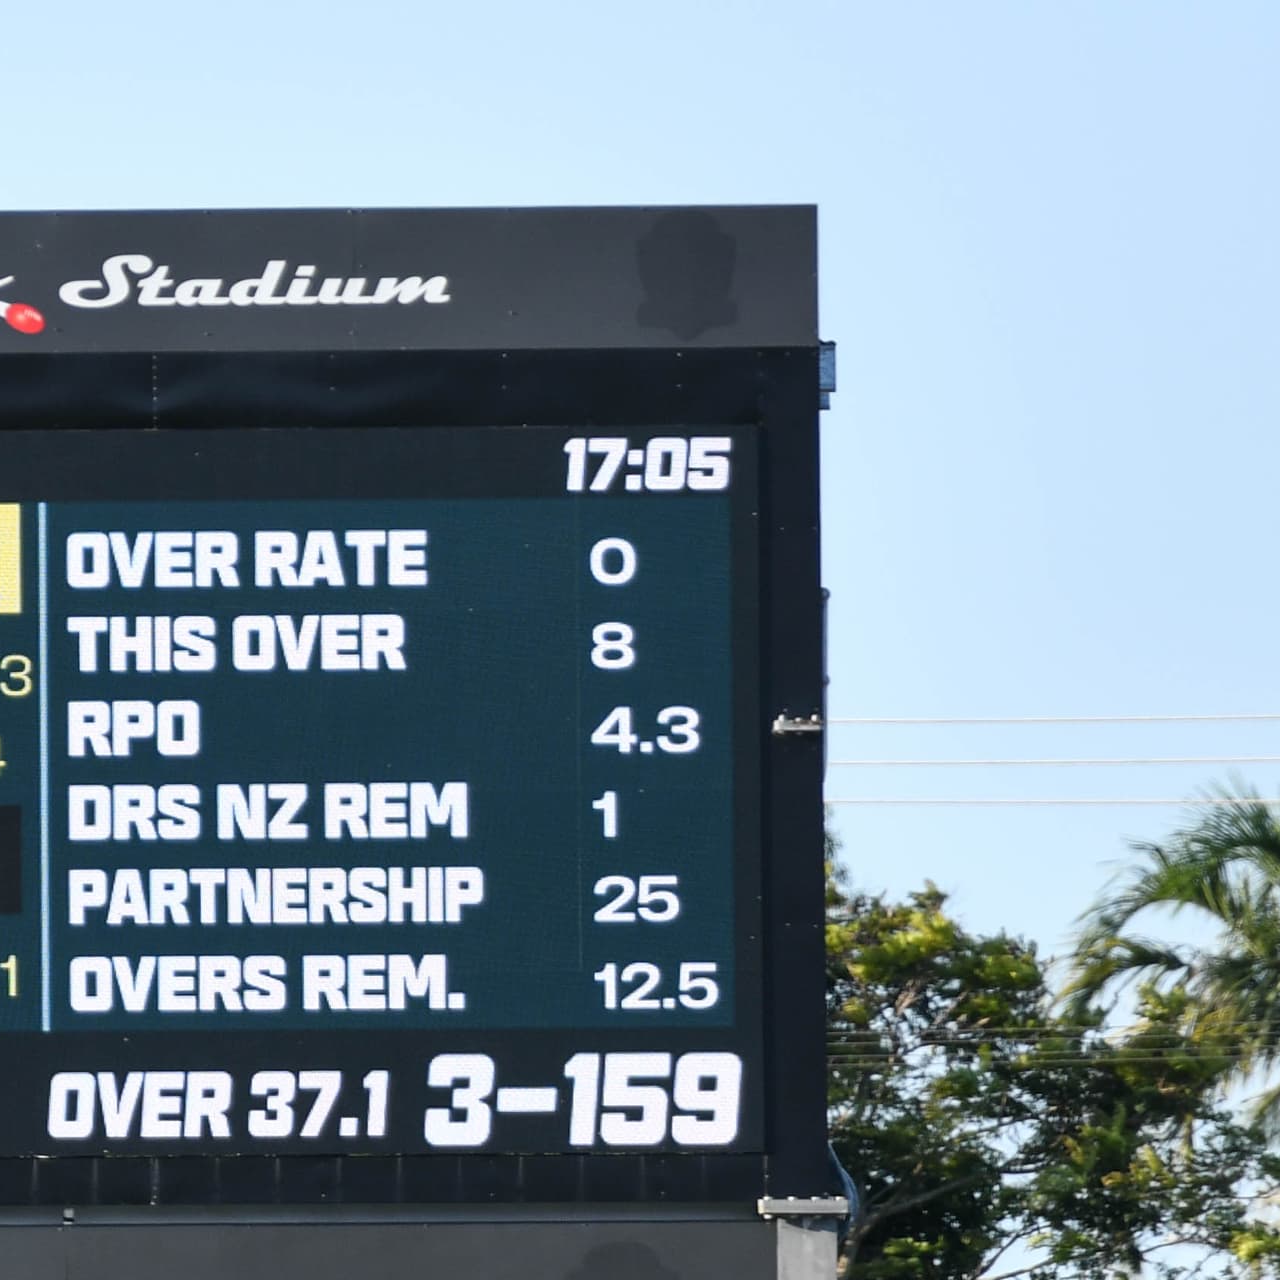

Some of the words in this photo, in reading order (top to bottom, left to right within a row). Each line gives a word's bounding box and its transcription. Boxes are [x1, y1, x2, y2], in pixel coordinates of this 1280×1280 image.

[59, 255, 450, 308] Stadium
[564, 437, 731, 491] 17:05
[66, 531, 240, 589] OVER
[255, 529, 428, 587] RATE
[590, 538, 637, 586] 0
[67, 616, 217, 672] THIS
[232, 614, 407, 672] OVER
[591, 622, 636, 670] 8
[68, 700, 201, 757] RPO
[591, 706, 700, 754] 4.3
[68, 784, 201, 841] DRS
[217, 783, 309, 840] NZ
[324, 782, 469, 839] REM
[592, 791, 617, 837] 1
[69, 867, 484, 926] PARTNERSHIP
[594, 875, 680, 922] 25
[70, 955, 287, 1013] OVERS
[302, 954, 466, 1011] REM.
[594, 962, 719, 1009] 12.5
[48, 1071, 233, 1138] OVER
[248, 1071, 389, 1137] 37.1
[425, 1052, 742, 1146] 3-159
